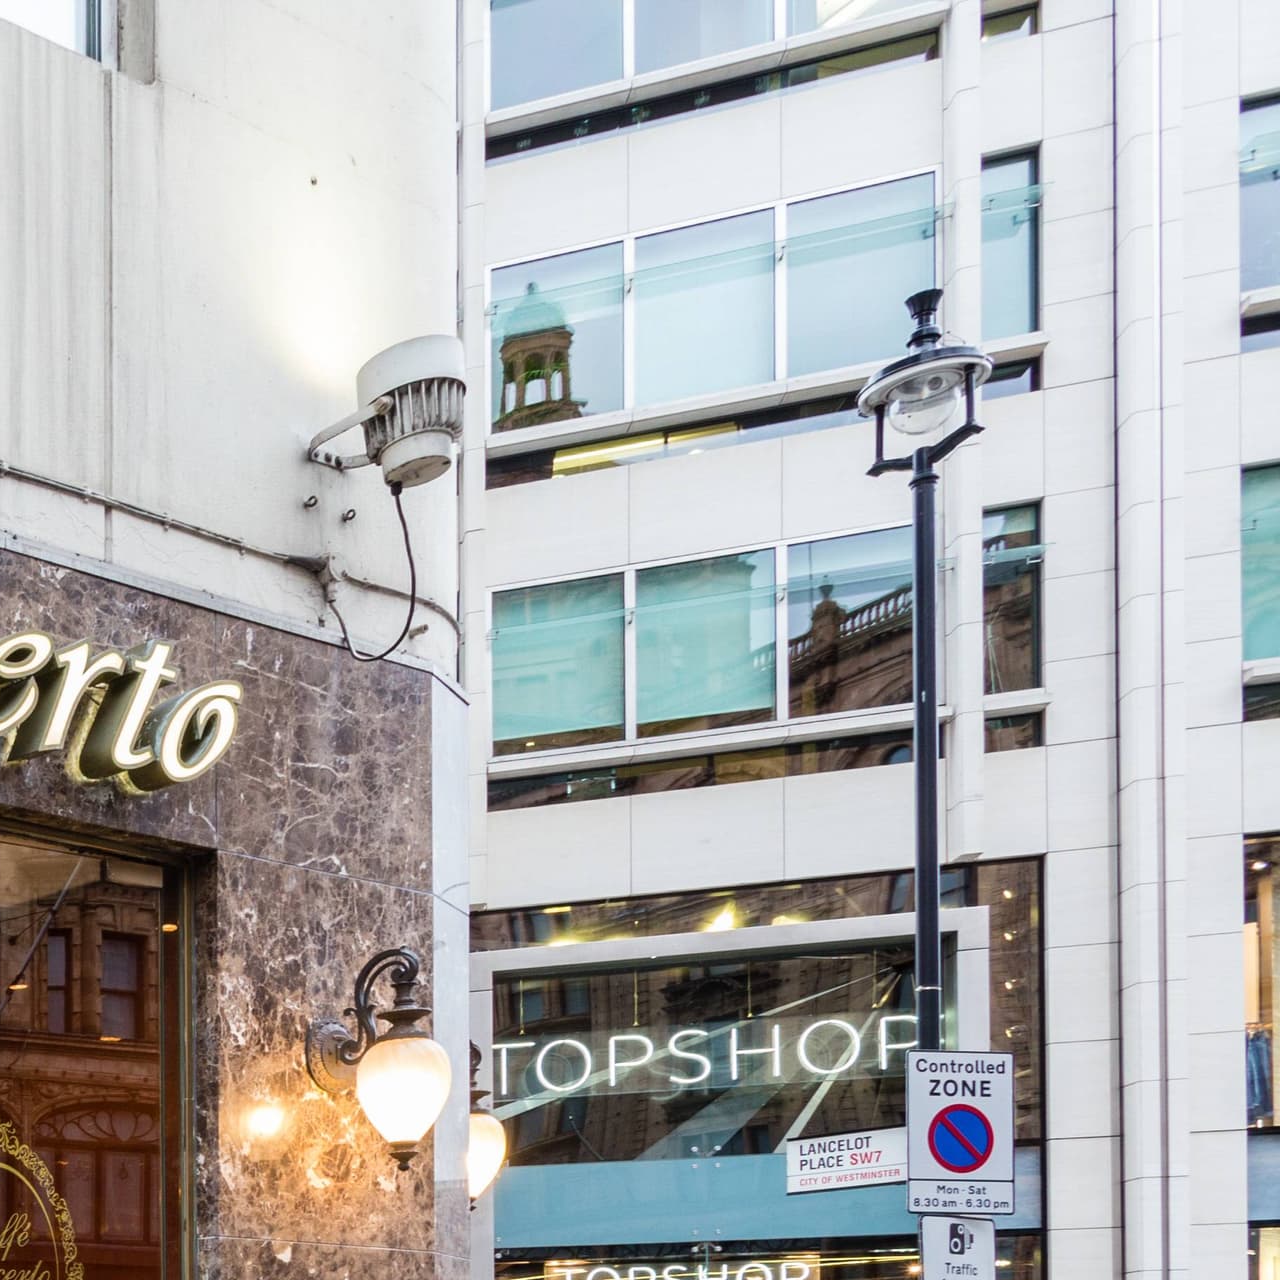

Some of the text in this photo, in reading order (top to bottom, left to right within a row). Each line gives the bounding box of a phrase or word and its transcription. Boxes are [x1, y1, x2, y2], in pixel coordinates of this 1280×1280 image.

[492, 1014, 919, 1096] TOPSHOP
[915, 1058, 1006, 1075] Controlled
[929, 1079, 992, 1097] ZONE
[799, 1136, 872, 1157] LANCELOT
[799, 1150, 883, 1171] PLACE SW7
[799, 1168, 901, 1187] CITY OF WESTMINSTER
[936, 1185, 959, 1194] Mon
[968, 1185, 986, 1195] Sat
[913, 1198, 939, 1207] 8.30
[965, 1198, 991, 1208] 6.30
[994, 1200, 1009, 1209] pm
[945, 1262, 978, 1276] Traffic
